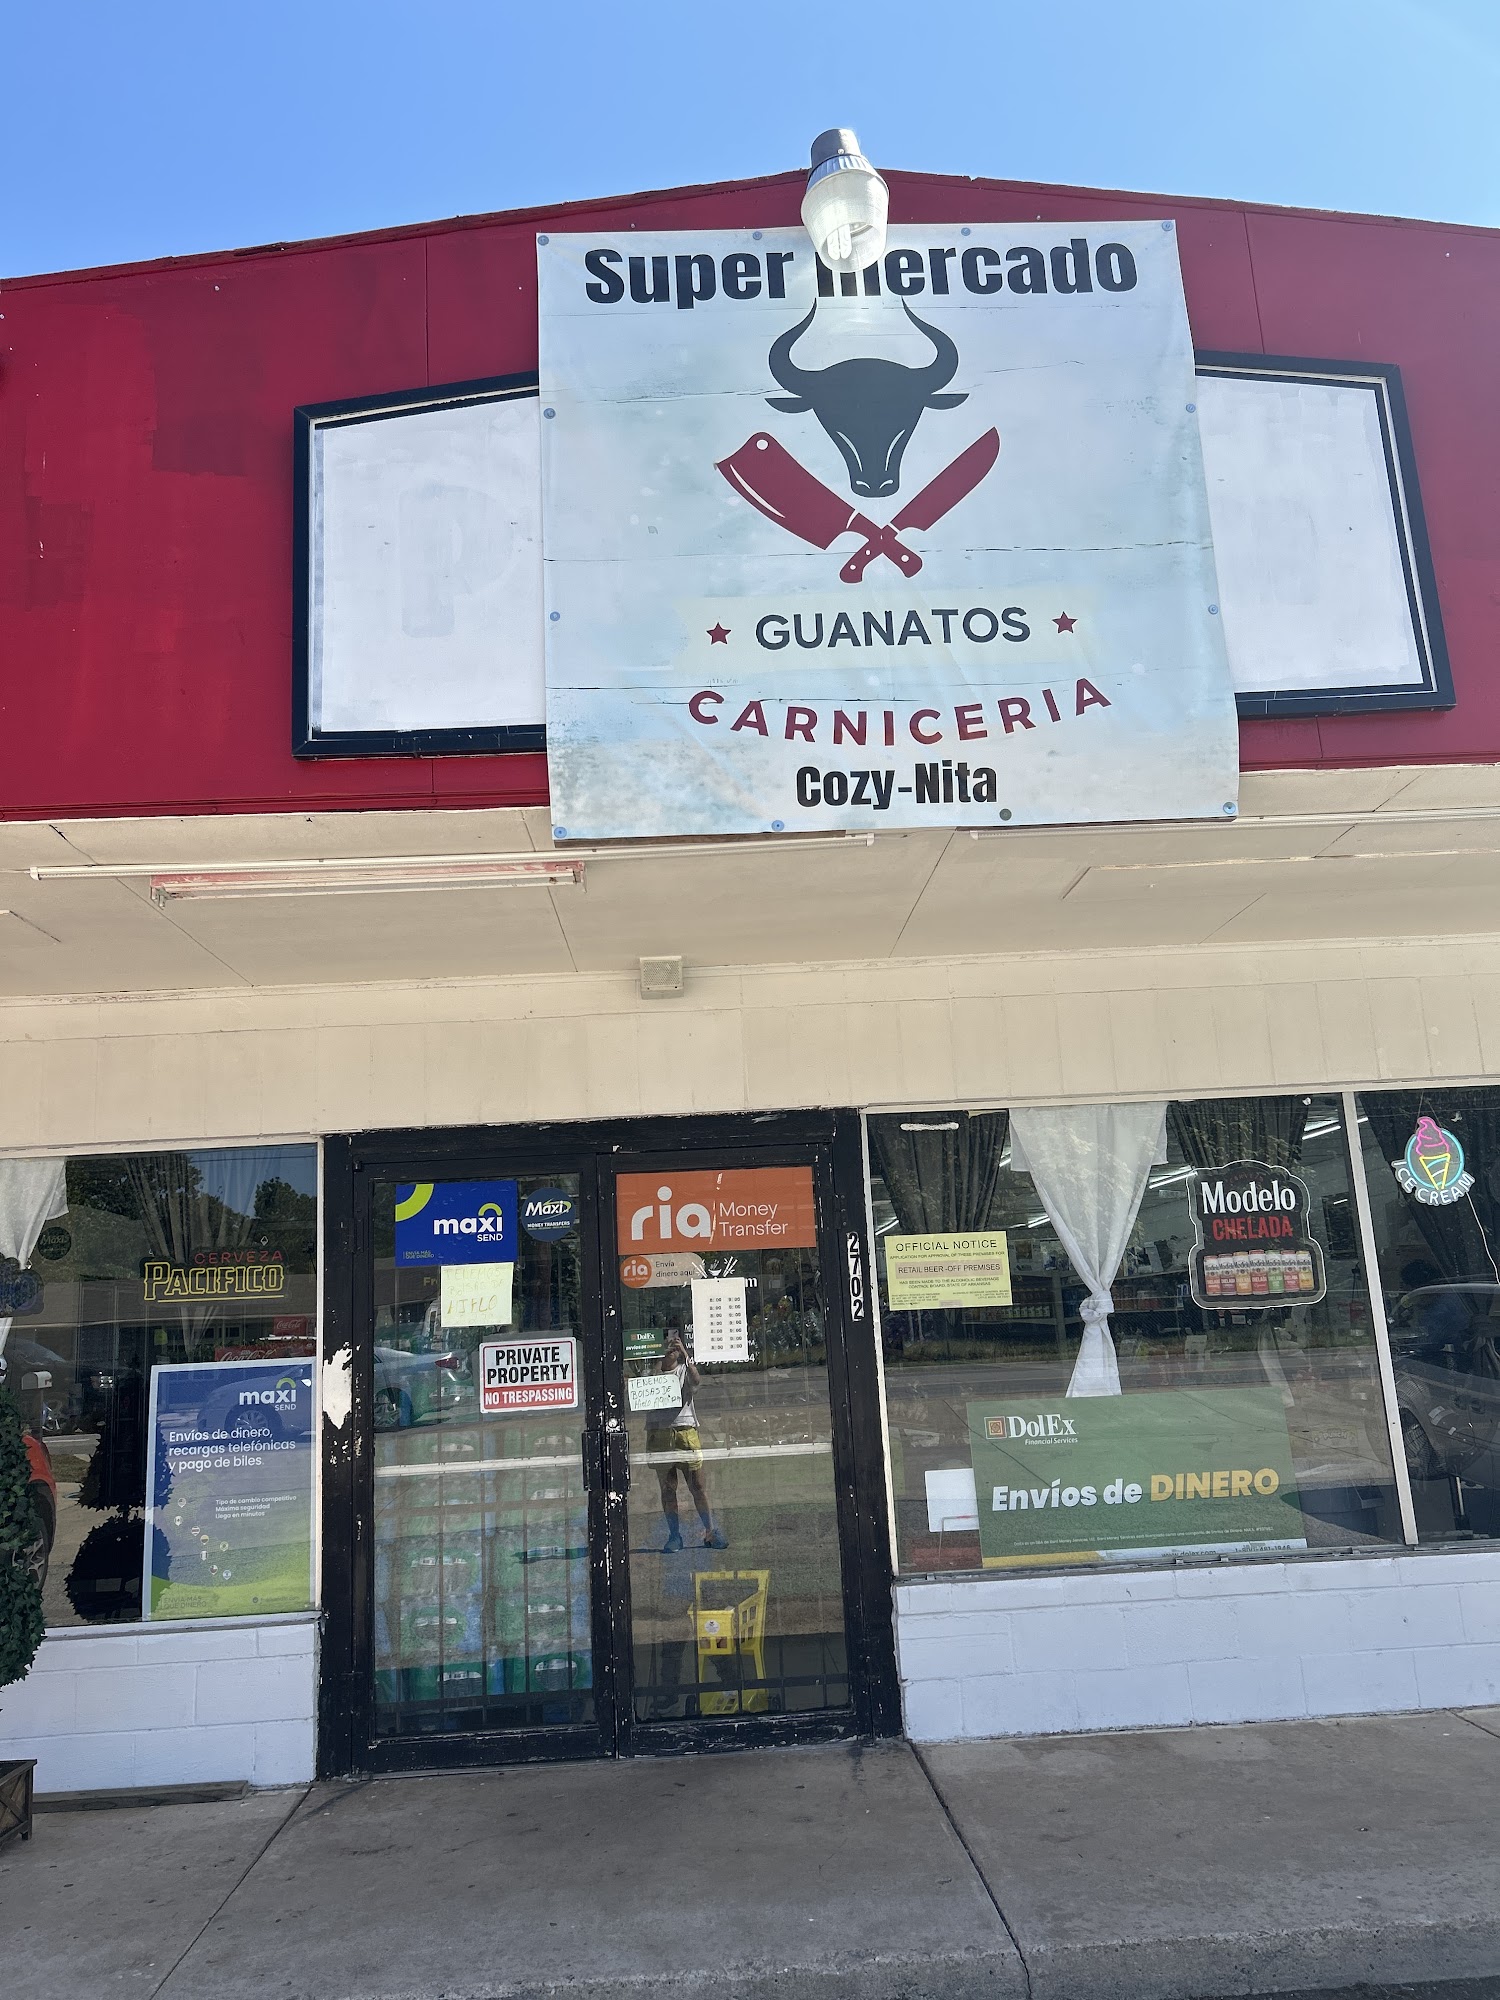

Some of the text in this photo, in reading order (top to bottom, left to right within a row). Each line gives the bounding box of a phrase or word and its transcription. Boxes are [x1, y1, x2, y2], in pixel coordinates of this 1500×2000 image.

[585, 248, 794, 309] Super
[755, 606, 1031, 650] GUANATOS
[688, 677, 1112, 746] CARNICERIA
[796, 760, 998, 810] Cozy-Nita
[1393, 1161, 1474, 1204] ICE CREAM
[1201, 1180, 1296, 1214] Modelo
[525, 1200, 564, 1216] Maxi
[631, 1186, 711, 1240] ria
[719, 1202, 778, 1219] Money
[434, 1216, 503, 1235] maxi
[719, 1220, 788, 1237] Transfer
[1212, 1216, 1293, 1240] CHELADA
[477, 1233, 503, 1242] SEND
[896, 1240, 997, 1252] OFFICIAL NOTICE
[194, 1250, 283, 1265] CERVEZA
[623, 1260, 648, 1276] ria
[656, 1270, 678, 1278] dinero
[849, 1232, 865, 1320] 2702
[898, 1266, 923, 1274] RETAIL
[144, 1261, 284, 1300] PACIFICO
[495, 1347, 559, 1365] PRIVATE
[487, 1364, 569, 1384] PROPERTY
[239, 1389, 296, 1405] maxi
[485, 1387, 572, 1405] NO TRESPASSING
[1007, 1413, 1077, 1438] DolEx
[169, 1428, 273, 1442] Envíos de dinero,
[1025, 1438, 1052, 1446] Financial
[169, 1440, 296, 1457] recargas telefónicas
[169, 1462, 176, 1473] y
[179, 1460, 211, 1473] pago
[214, 1457, 230, 1468] de
[992, 1467, 1280, 1511] Envíos de DINERO
[261, 1495, 297, 1503] competitivo
